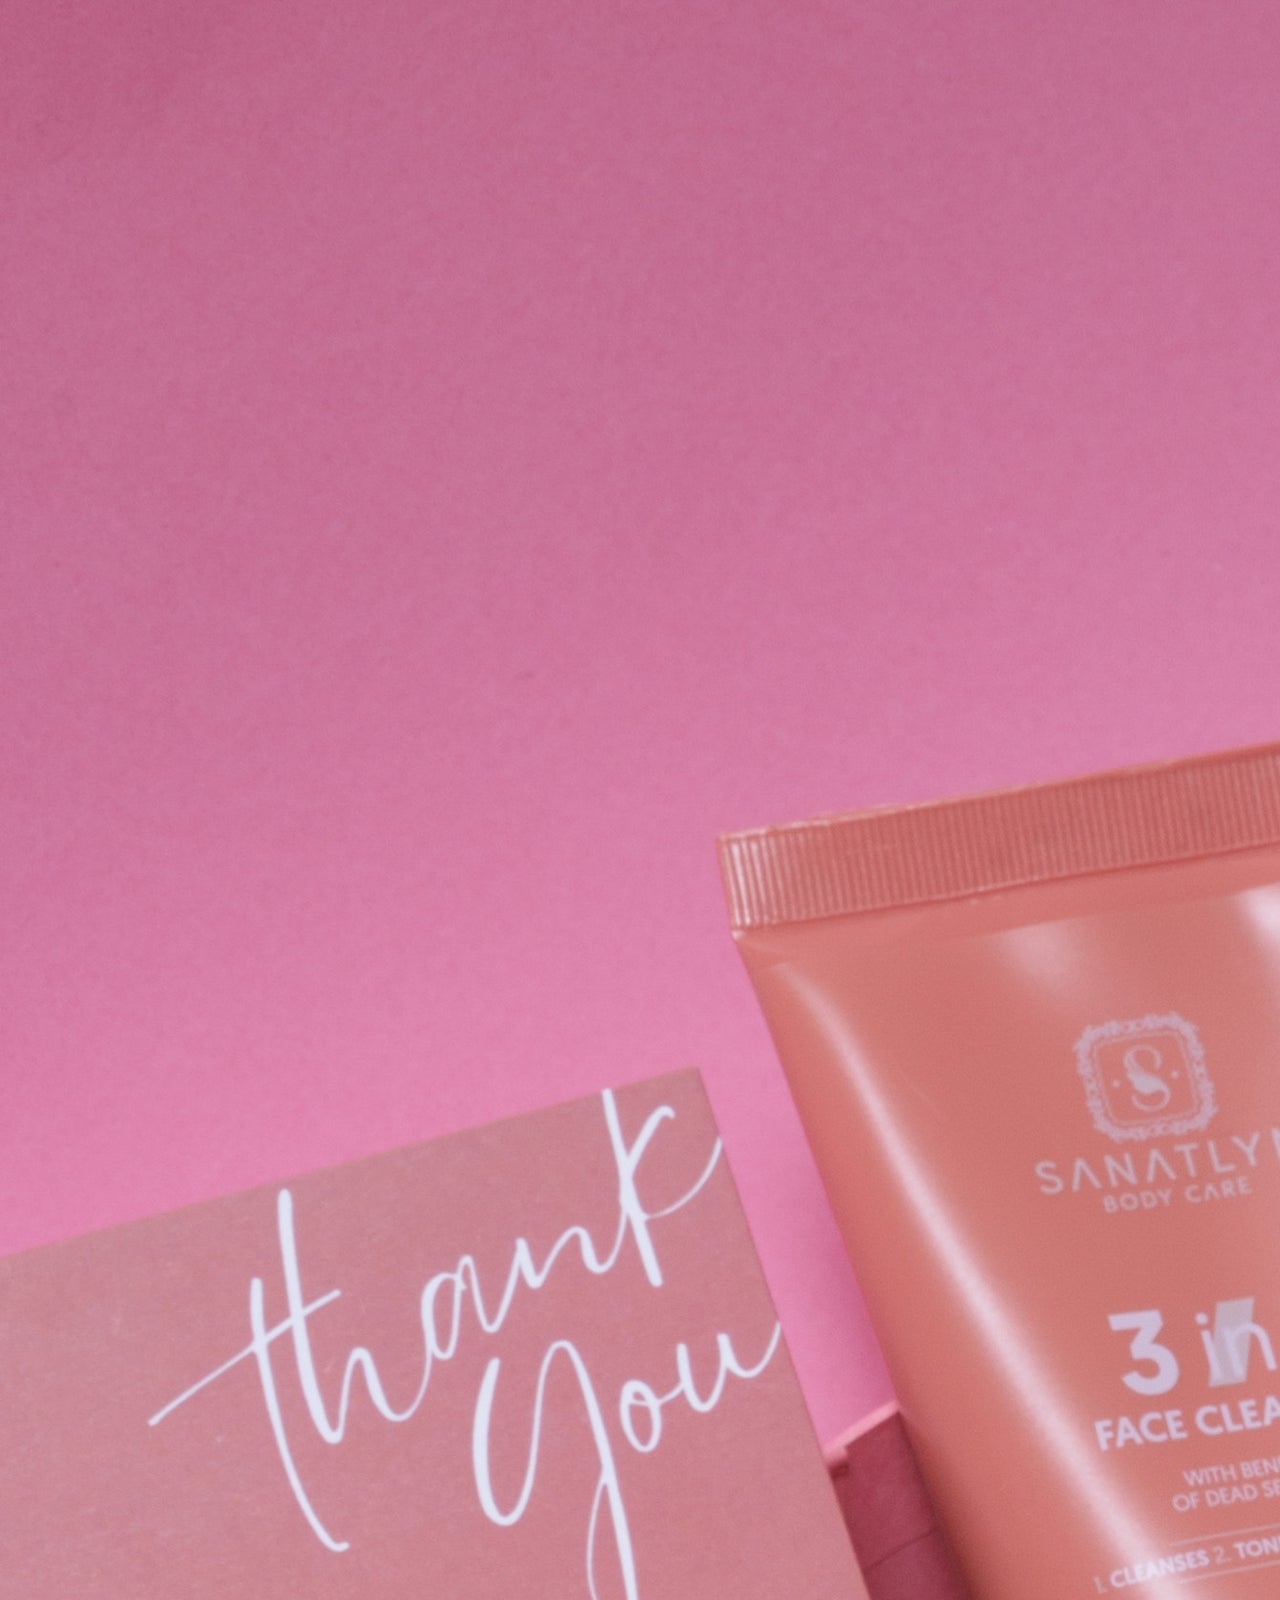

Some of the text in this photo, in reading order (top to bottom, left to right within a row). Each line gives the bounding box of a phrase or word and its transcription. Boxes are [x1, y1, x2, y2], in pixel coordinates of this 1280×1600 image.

[1103, 1176, 1253, 1214] BODY CARE
[149, 1088, 723, 1551] thank
[1107, 1309, 1180, 1396] 3
[1195, 1311, 1278, 1386] in
[1094, 1408, 1188, 1451] FACE
[1182, 1462, 1238, 1487] WITH
[1172, 1492, 1200, 1513] OF
[1204, 1484, 1259, 1507] DEAD
[1110, 1549, 1211, 1588] CLEANSES
